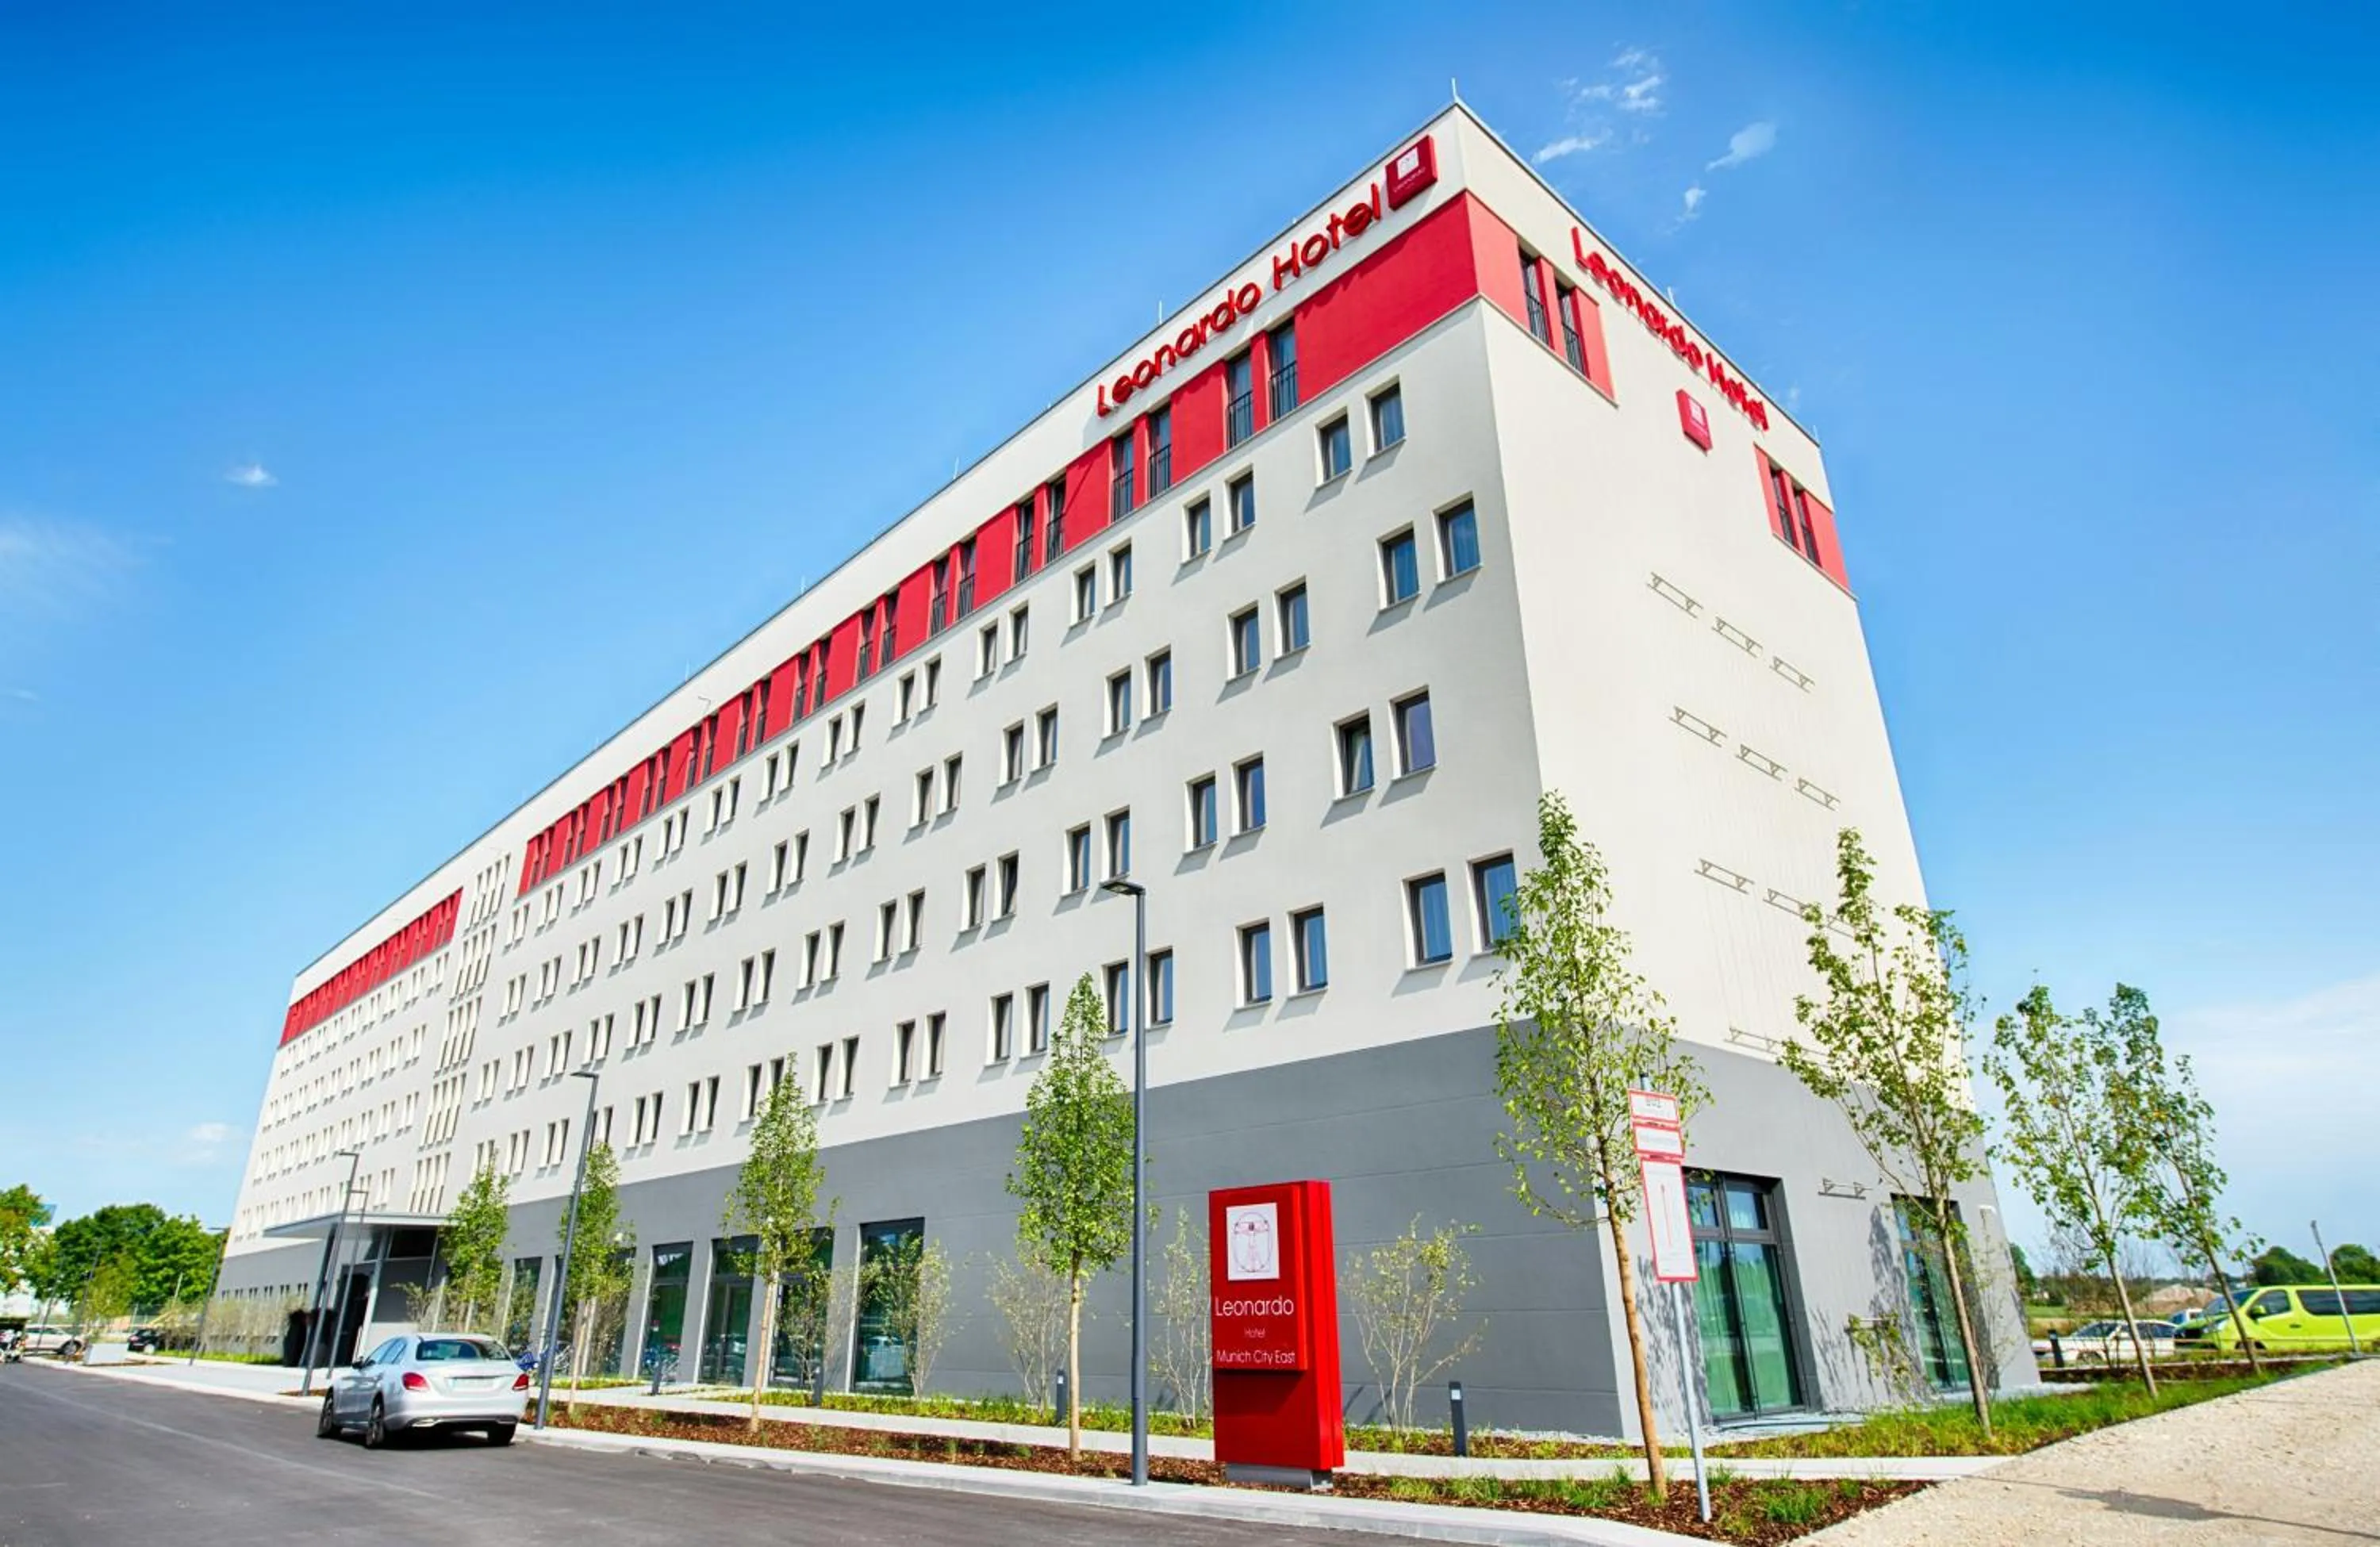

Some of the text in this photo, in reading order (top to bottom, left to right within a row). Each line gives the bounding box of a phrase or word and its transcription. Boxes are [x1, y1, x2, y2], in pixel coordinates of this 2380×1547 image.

[1097, 182, 1381, 417] Leonardo Hotel
[1571, 226, 1769, 432] Leonardo Hotel
[1215, 1295, 1294, 1316] Leonardo
[1243, 1327, 1266, 1339] Hotel
[1216, 1349, 1296, 1365] Munich City East
